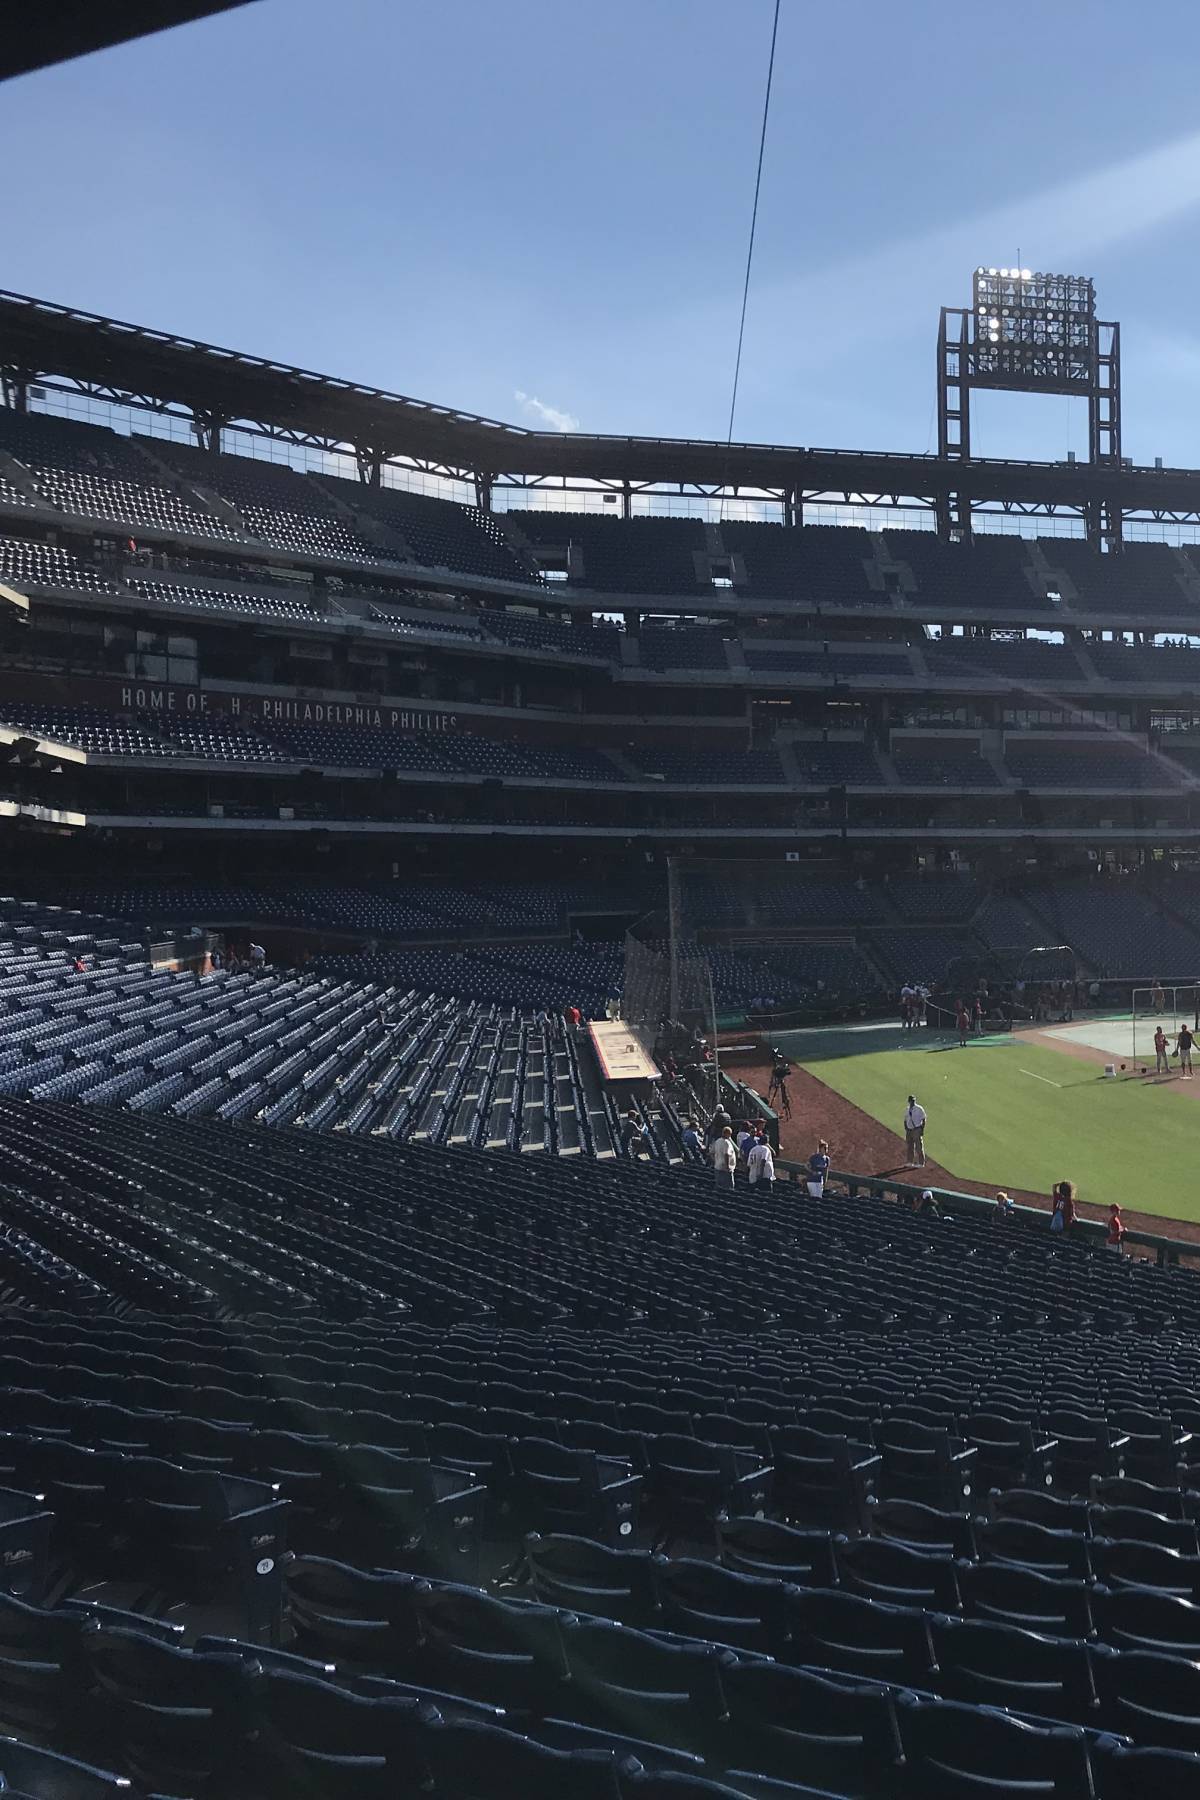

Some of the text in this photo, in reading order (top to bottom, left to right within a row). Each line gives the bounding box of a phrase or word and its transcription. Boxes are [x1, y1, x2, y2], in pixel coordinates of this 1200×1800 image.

[122, 687, 176, 711] HOME
[187, 693, 208, 712] OF
[263, 700, 382, 727] PHILADELPHIA
[391, 711, 457, 731] PHILLIES
